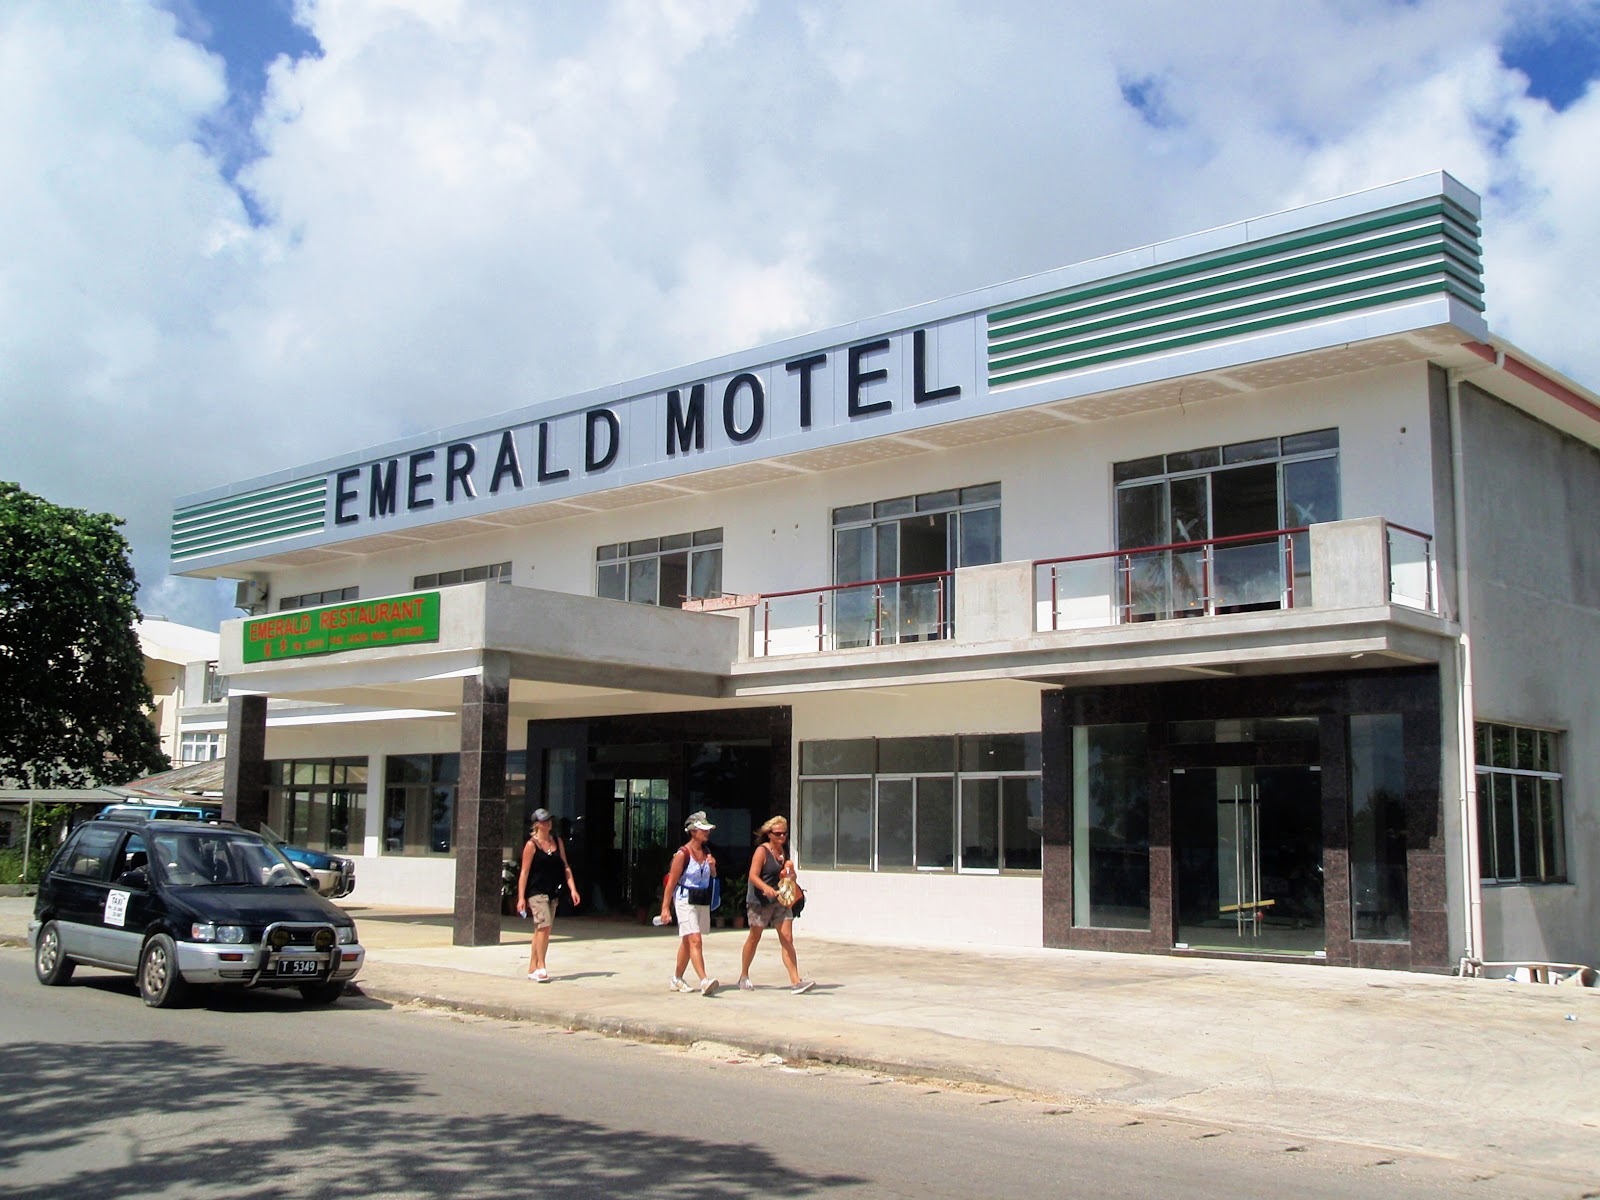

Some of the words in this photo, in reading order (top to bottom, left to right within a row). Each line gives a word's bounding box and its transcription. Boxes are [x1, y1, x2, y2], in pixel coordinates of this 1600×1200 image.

[335, 408, 621, 524] EMERALD
[666, 328, 962, 456] MOTEL
[250, 614, 311, 642] EMERALD
[320, 598, 425, 630] RESTAURANT
[112, 897, 123, 906] TAXI
[282, 961, 288, 972] T
[293, 961, 316, 972] 5349
